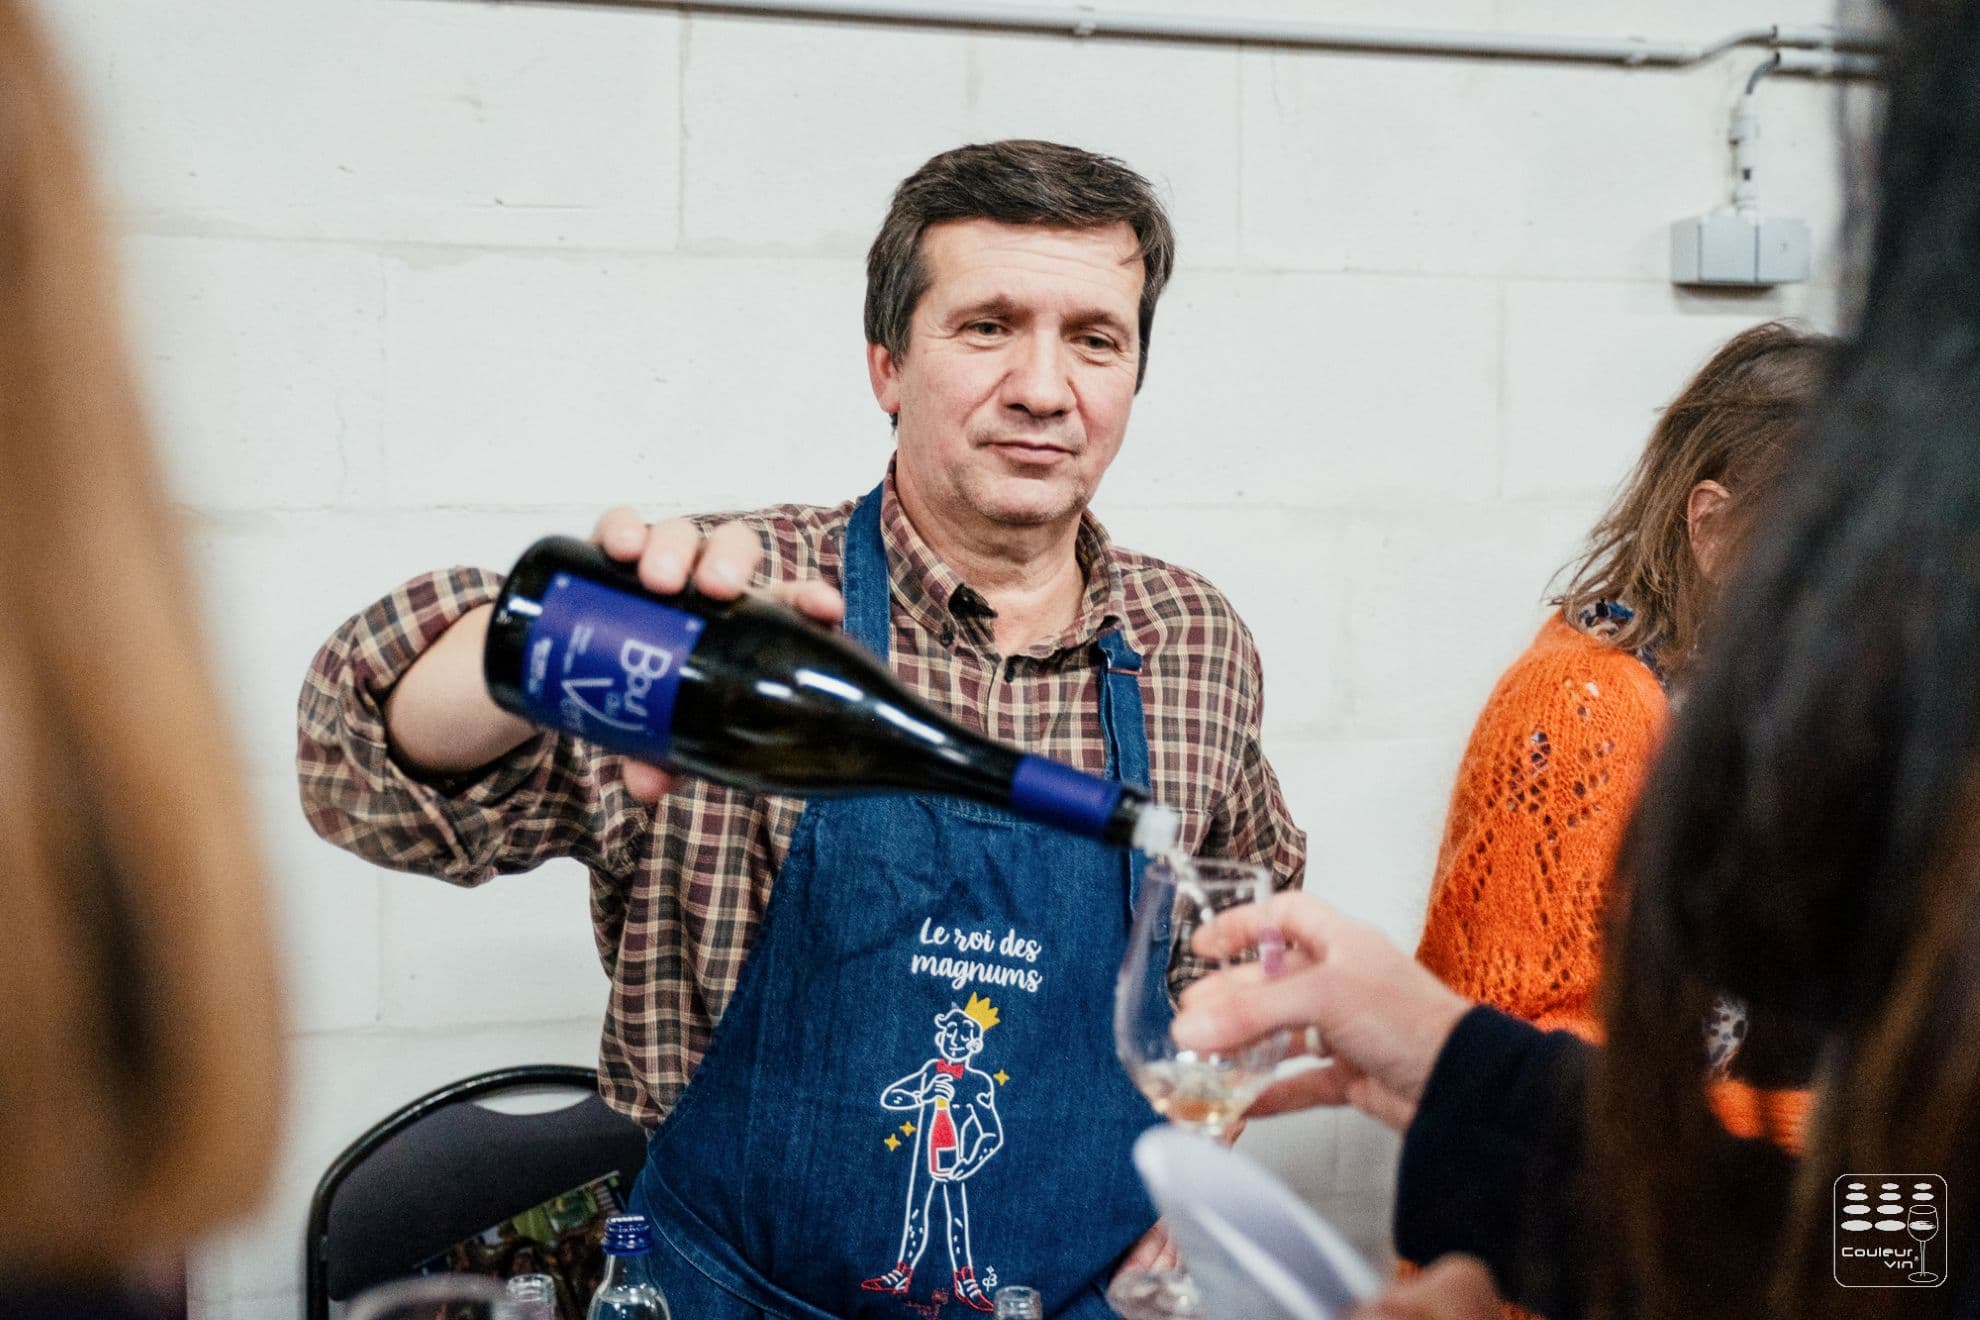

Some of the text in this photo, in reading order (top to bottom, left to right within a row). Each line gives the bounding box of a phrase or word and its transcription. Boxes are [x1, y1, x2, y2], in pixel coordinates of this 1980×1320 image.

[919, 916, 1042, 963] Le roi des
[911, 954, 1043, 993] magnums
